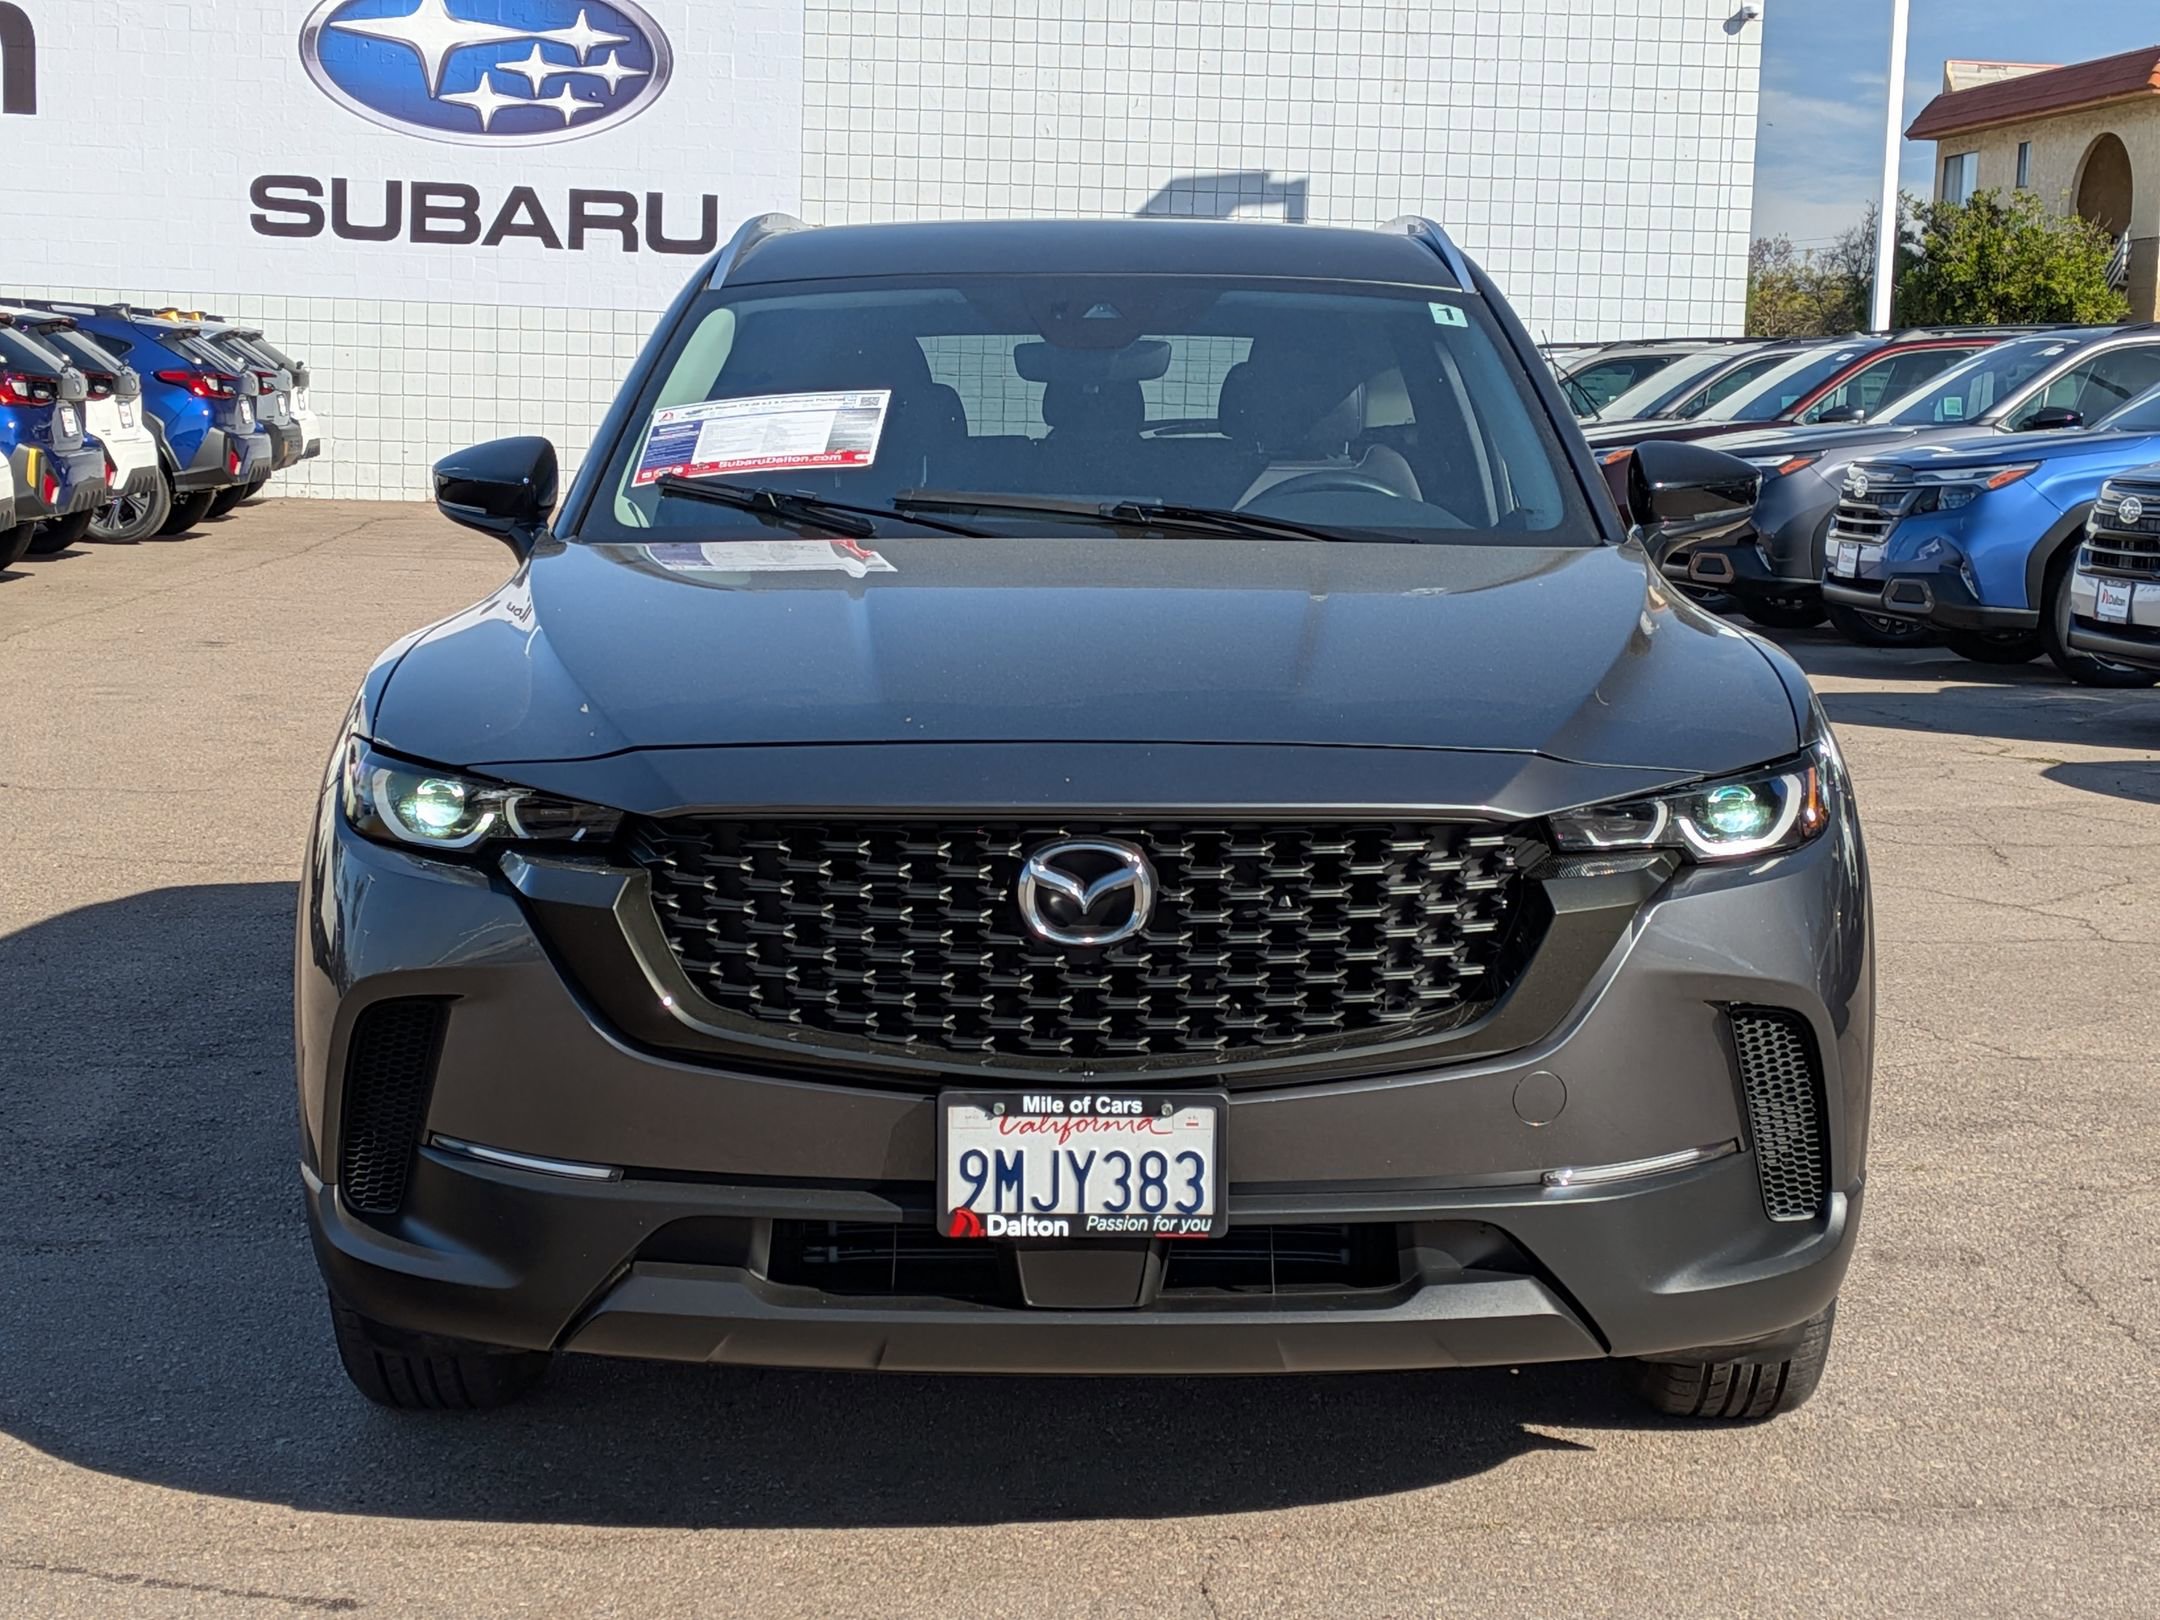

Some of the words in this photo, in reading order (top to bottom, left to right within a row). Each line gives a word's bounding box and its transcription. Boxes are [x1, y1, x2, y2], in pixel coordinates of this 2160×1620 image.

[250, 175, 718, 255] SUBARU
[718, 453, 842, 469] SubaruDalton.com
[1022, 1096, 1063, 1114] Mile
[1069, 1096, 1092, 1114] of
[1095, 1096, 1143, 1114] Cars
[999, 1115, 1173, 1145] California
[959, 1149, 1206, 1214] 9MJY383
[987, 1214, 1069, 1237] Dalton
[1086, 1215, 1148, 1232] Passion
[1152, 1215, 1177, 1232] for
[1179, 1219, 1212, 1234] you
